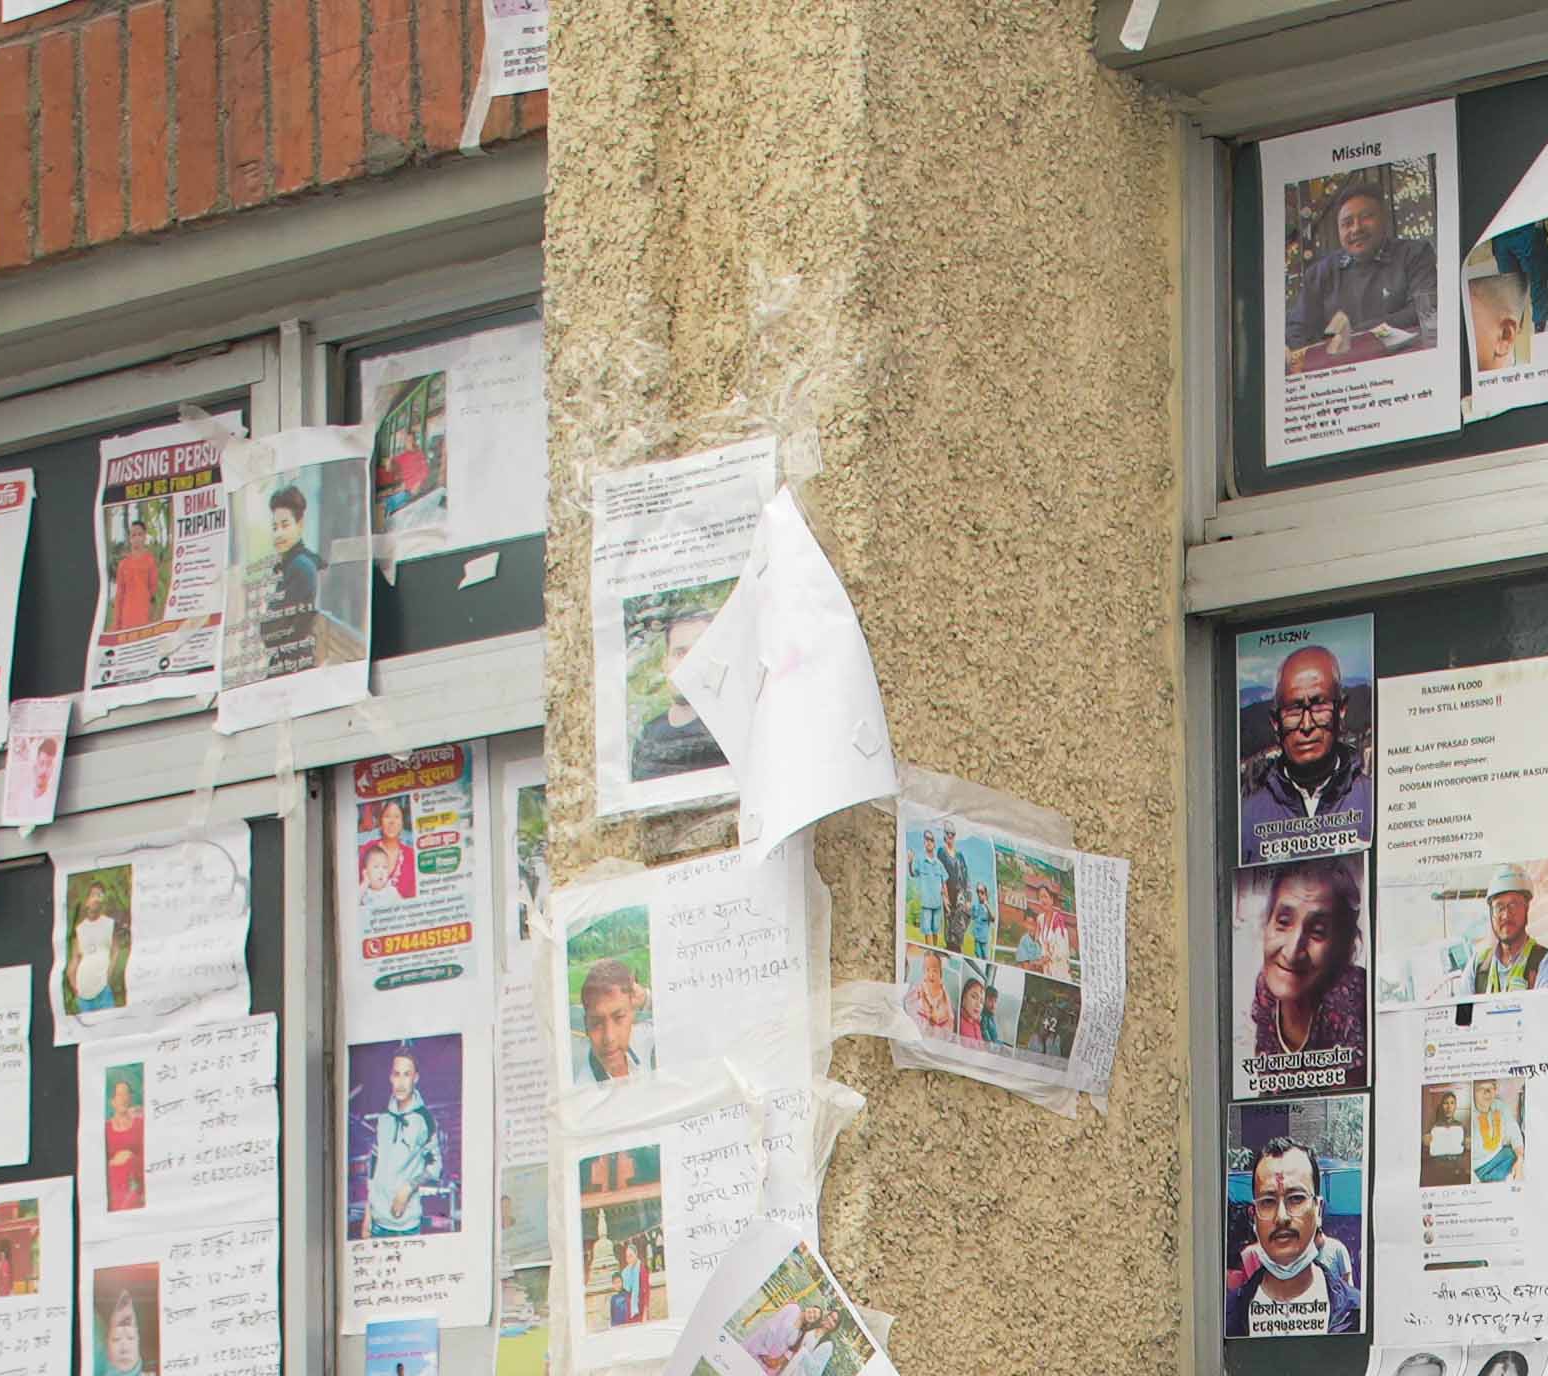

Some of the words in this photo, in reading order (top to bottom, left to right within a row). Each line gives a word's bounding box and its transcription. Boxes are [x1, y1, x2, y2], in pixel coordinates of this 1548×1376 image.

[1332, 142, 1382, 163] Missing
[109, 450, 169, 485] MISSING
[174, 441, 220, 474] PERSO
[125, 482, 151, 499] HELP
[155, 479, 167, 495] US
[171, 474, 194, 492] FIND
[184, 488, 217, 515] BIMAL
[177, 508, 225, 538] TRIPATHI
[1421, 684, 1455, 695] RASUWA
[1457, 680, 1483, 691] FLOOD
[1437, 701, 1458, 713] STILL
[1460, 697, 1494, 710] MISSING
[1414, 742, 1435, 753] AJAY
[1437, 737, 1469, 750] PRASAD
[1470, 734, 1495, 746] SINGH
[1399, 780, 1432, 793] DOOSAN
[1434, 774, 1488, 788] HYDROPOWER
[1427, 813, 1472, 826] DHANUSHA
